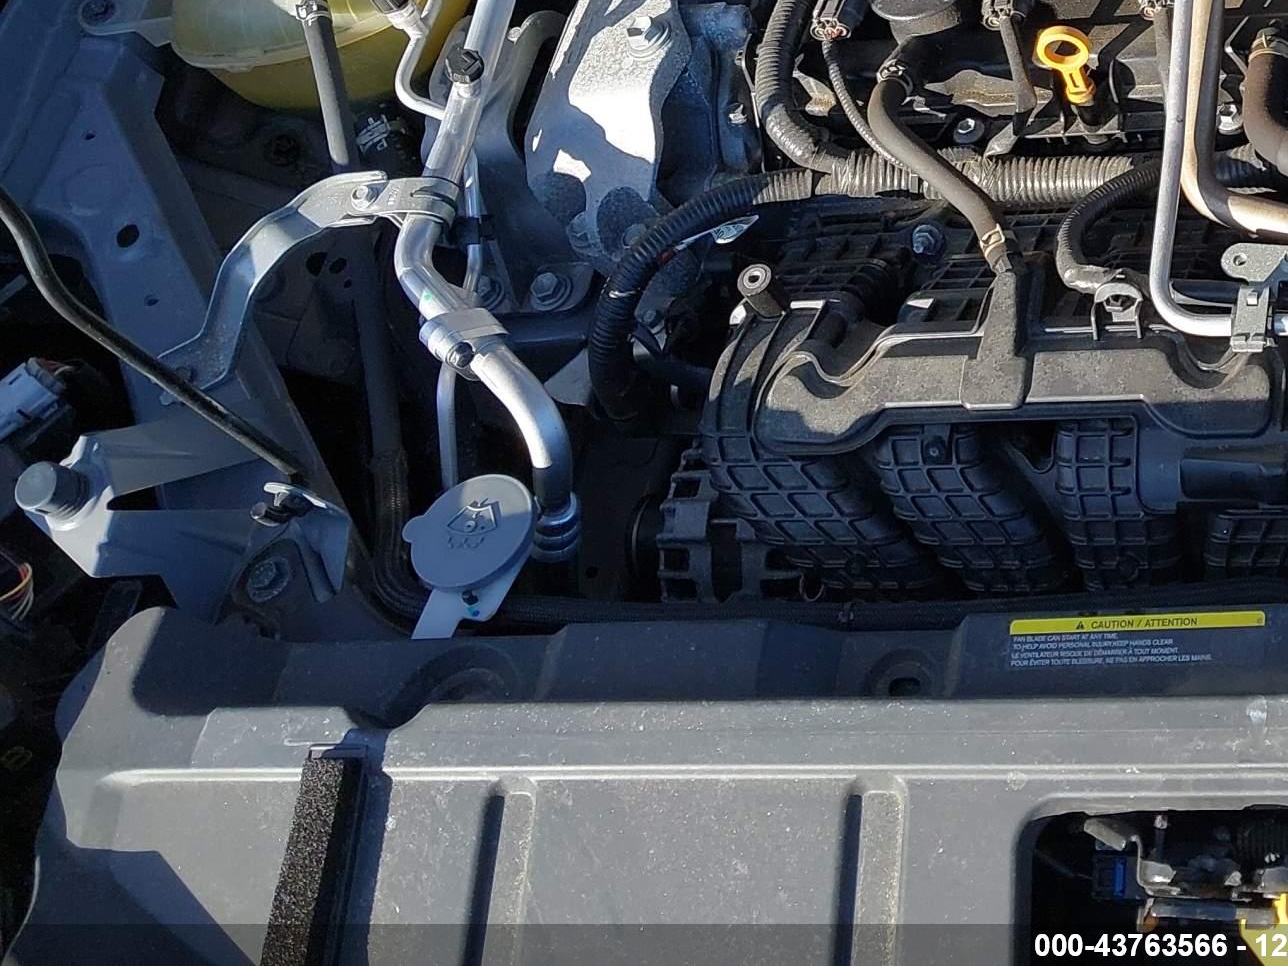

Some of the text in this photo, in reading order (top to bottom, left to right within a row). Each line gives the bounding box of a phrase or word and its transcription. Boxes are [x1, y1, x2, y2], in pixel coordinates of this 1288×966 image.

[1091, 619, 1134, 630] CAUTION
[1144, 617, 1198, 628] ATTENTION
[1134, 647, 1151, 655] TOUT
[1010, 659, 1028, 667] POUR
[1178, 653, 1190, 662] LES
